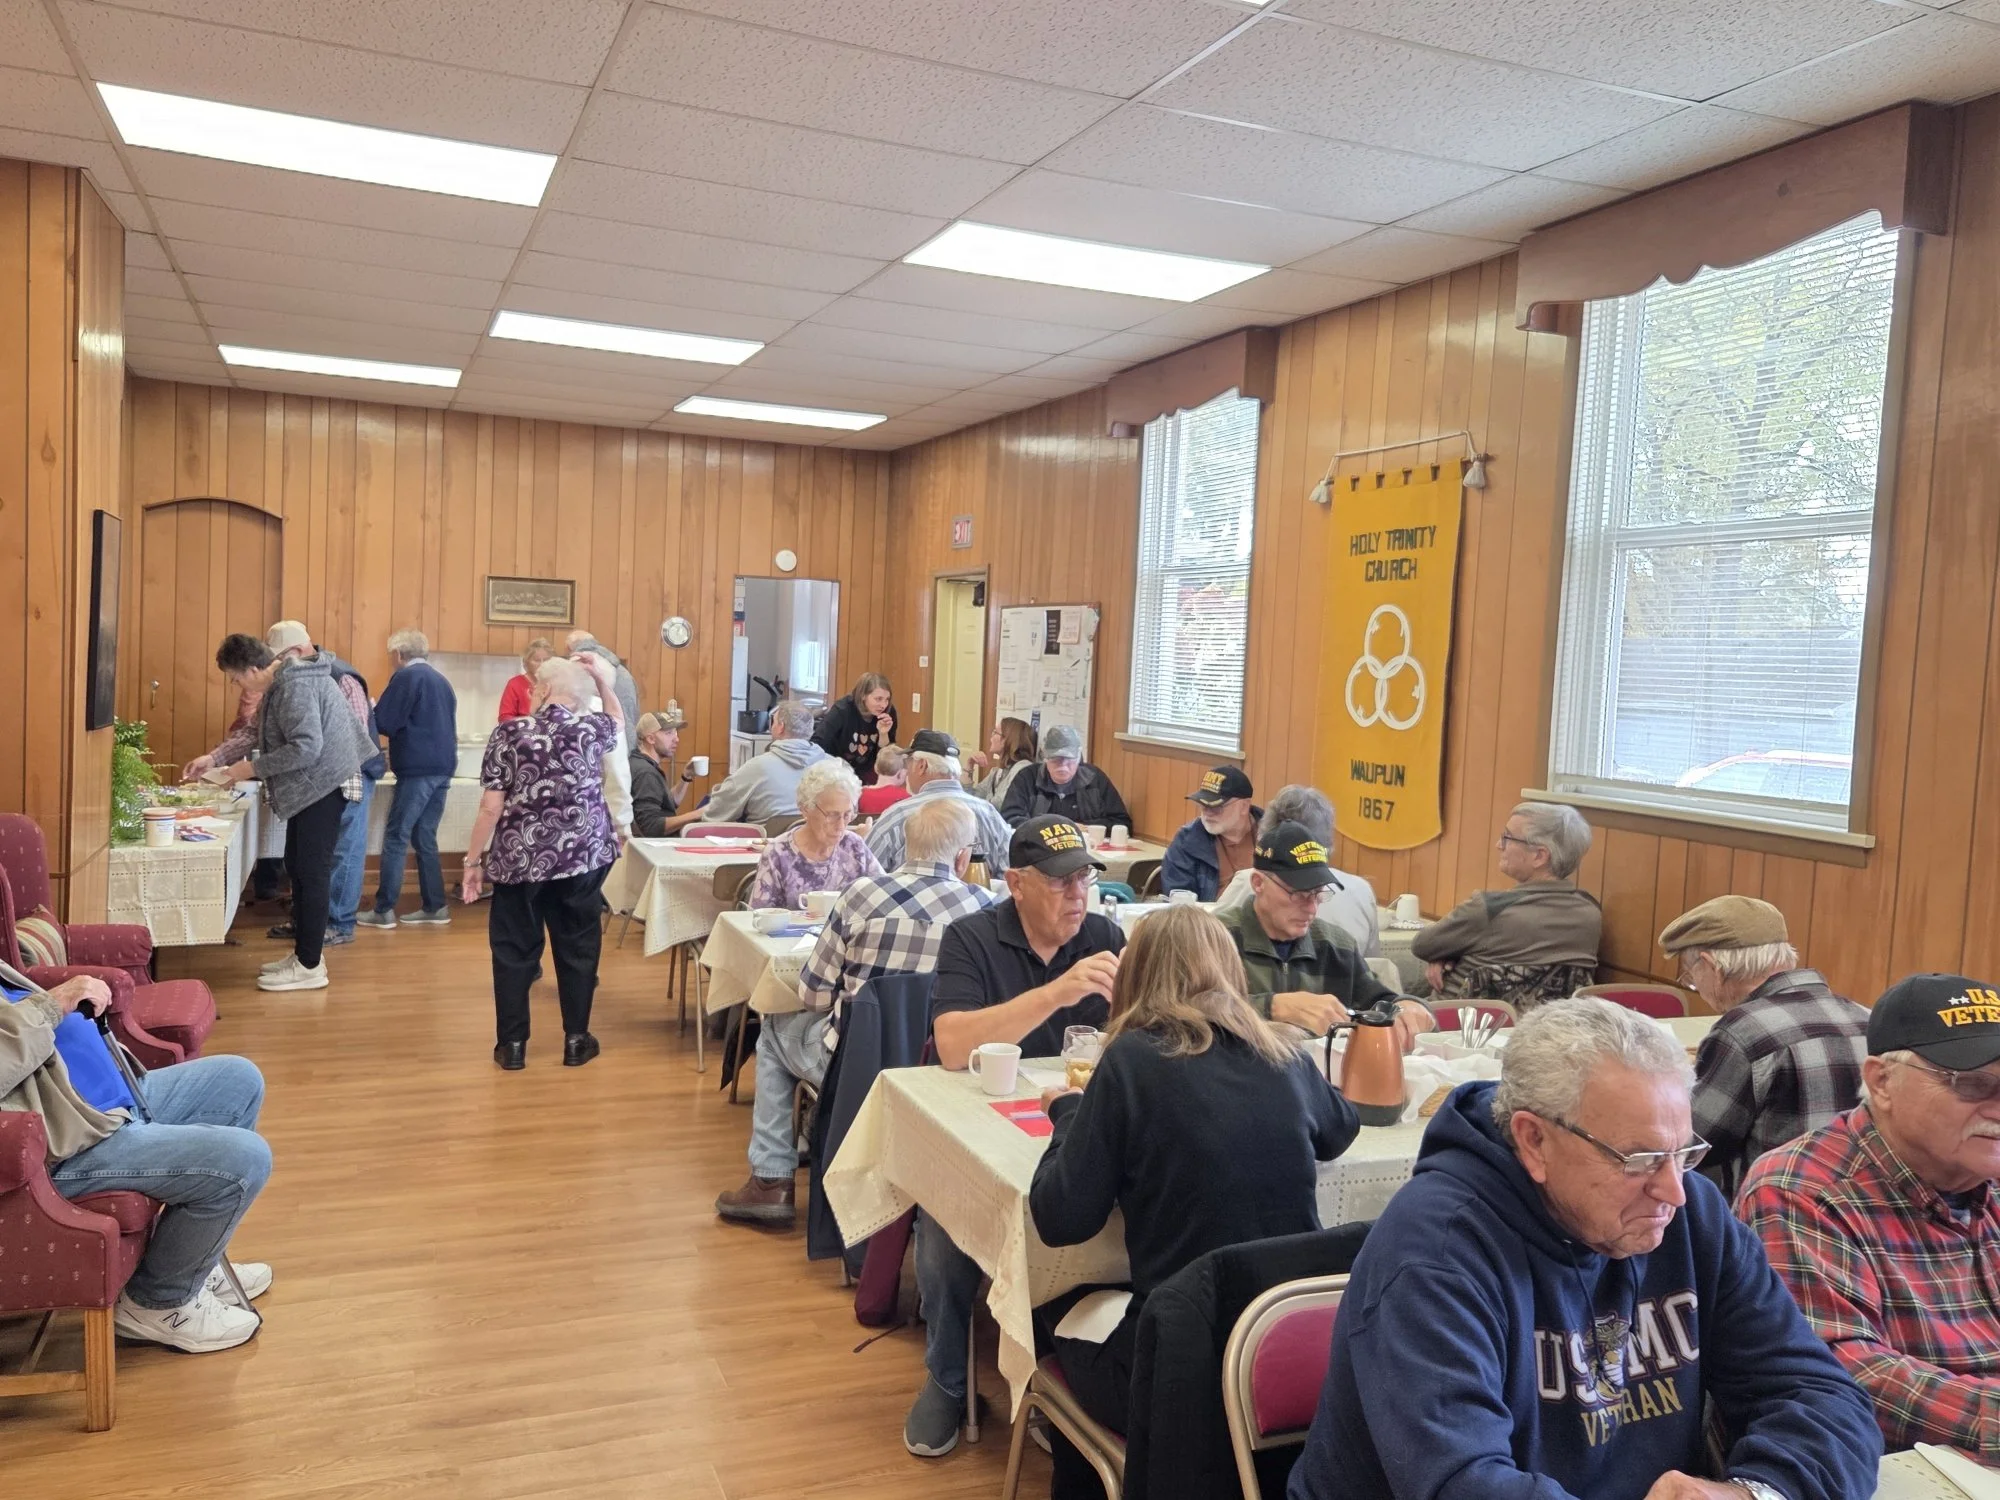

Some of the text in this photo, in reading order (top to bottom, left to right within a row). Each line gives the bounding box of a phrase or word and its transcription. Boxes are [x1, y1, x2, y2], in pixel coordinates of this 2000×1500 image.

[1350, 525, 1437, 557] HOLY TRINITY
[1364, 557, 1418, 582] CHURCH
[1350, 758, 1406, 788] WAUPUN
[1358, 795, 1395, 822] 1867
[1534, 1288, 1700, 1405] USMC
[1580, 1376, 1683, 1448] VETRAN
